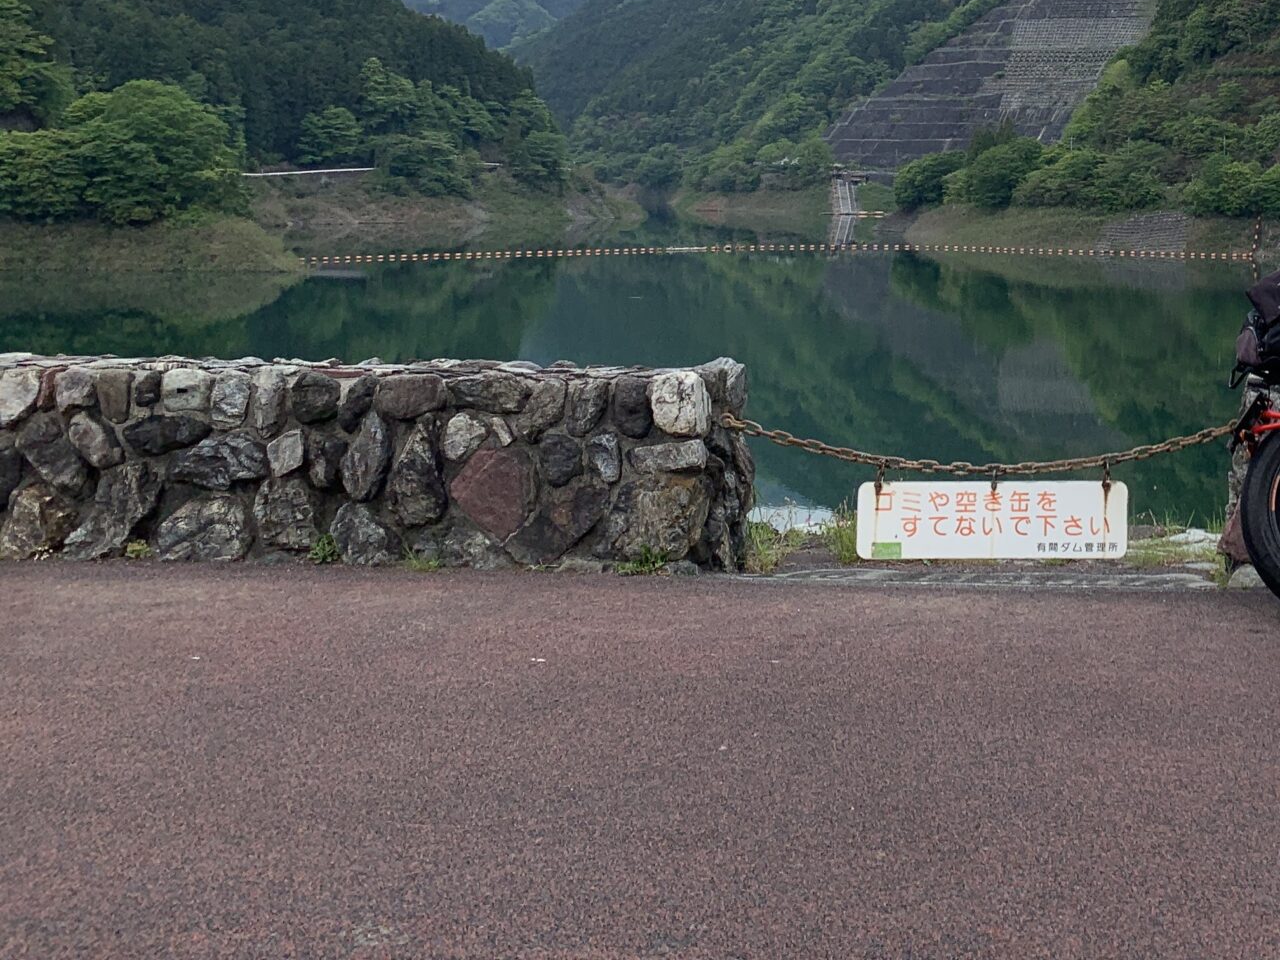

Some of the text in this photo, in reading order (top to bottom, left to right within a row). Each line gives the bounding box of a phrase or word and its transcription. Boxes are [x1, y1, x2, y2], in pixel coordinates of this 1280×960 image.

[875, 491, 1057, 513] ゴミや空き缶を
[901, 515, 1110, 537] すてないで下さい
